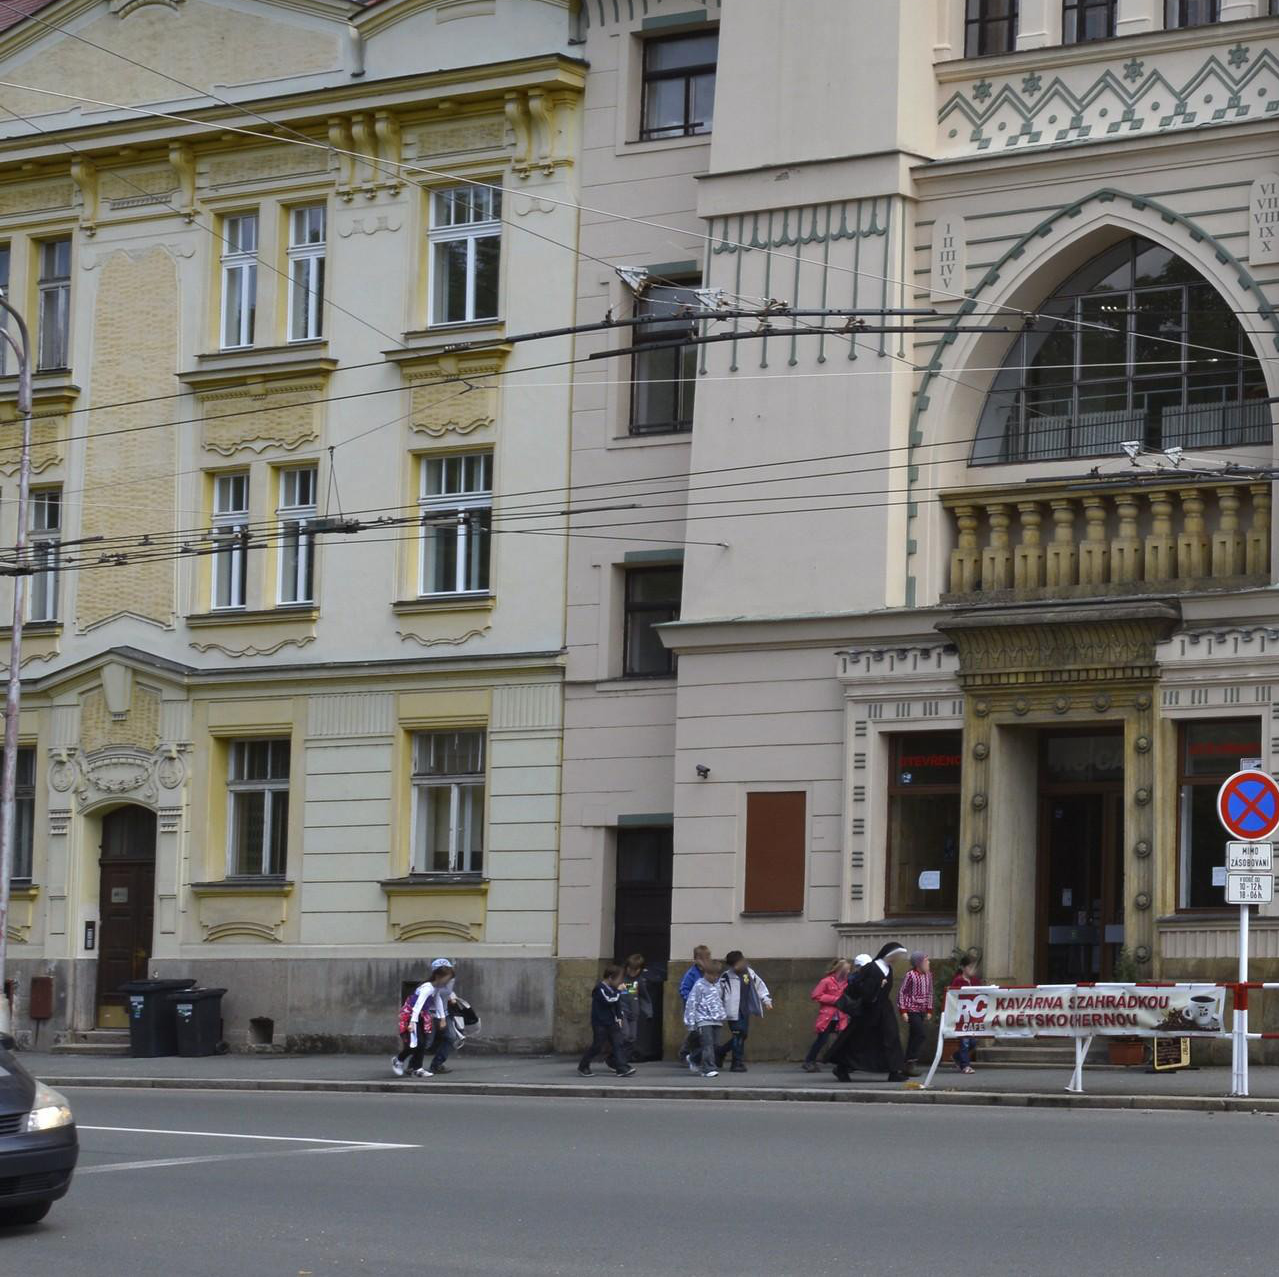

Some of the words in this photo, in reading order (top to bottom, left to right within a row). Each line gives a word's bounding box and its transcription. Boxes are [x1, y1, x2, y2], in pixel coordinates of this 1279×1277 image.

[1260, 183, 1276, 195] VI
[1257, 197, 1278, 209] VII
[1254, 211, 1279, 224] VIII
[946, 223, 951, 234] I
[1259, 226, 1275, 238] IX
[944, 236, 954, 248] II
[1261, 241, 1272, 252] X
[940, 250, 956, 262] III
[940, 263, 956, 276] IV
[942, 277, 952, 288] V
[1242, 847, 1258, 856] MIMO
[995, 994, 1063, 1010] KAVÁRNA
[991, 1014, 1000, 1027] A
